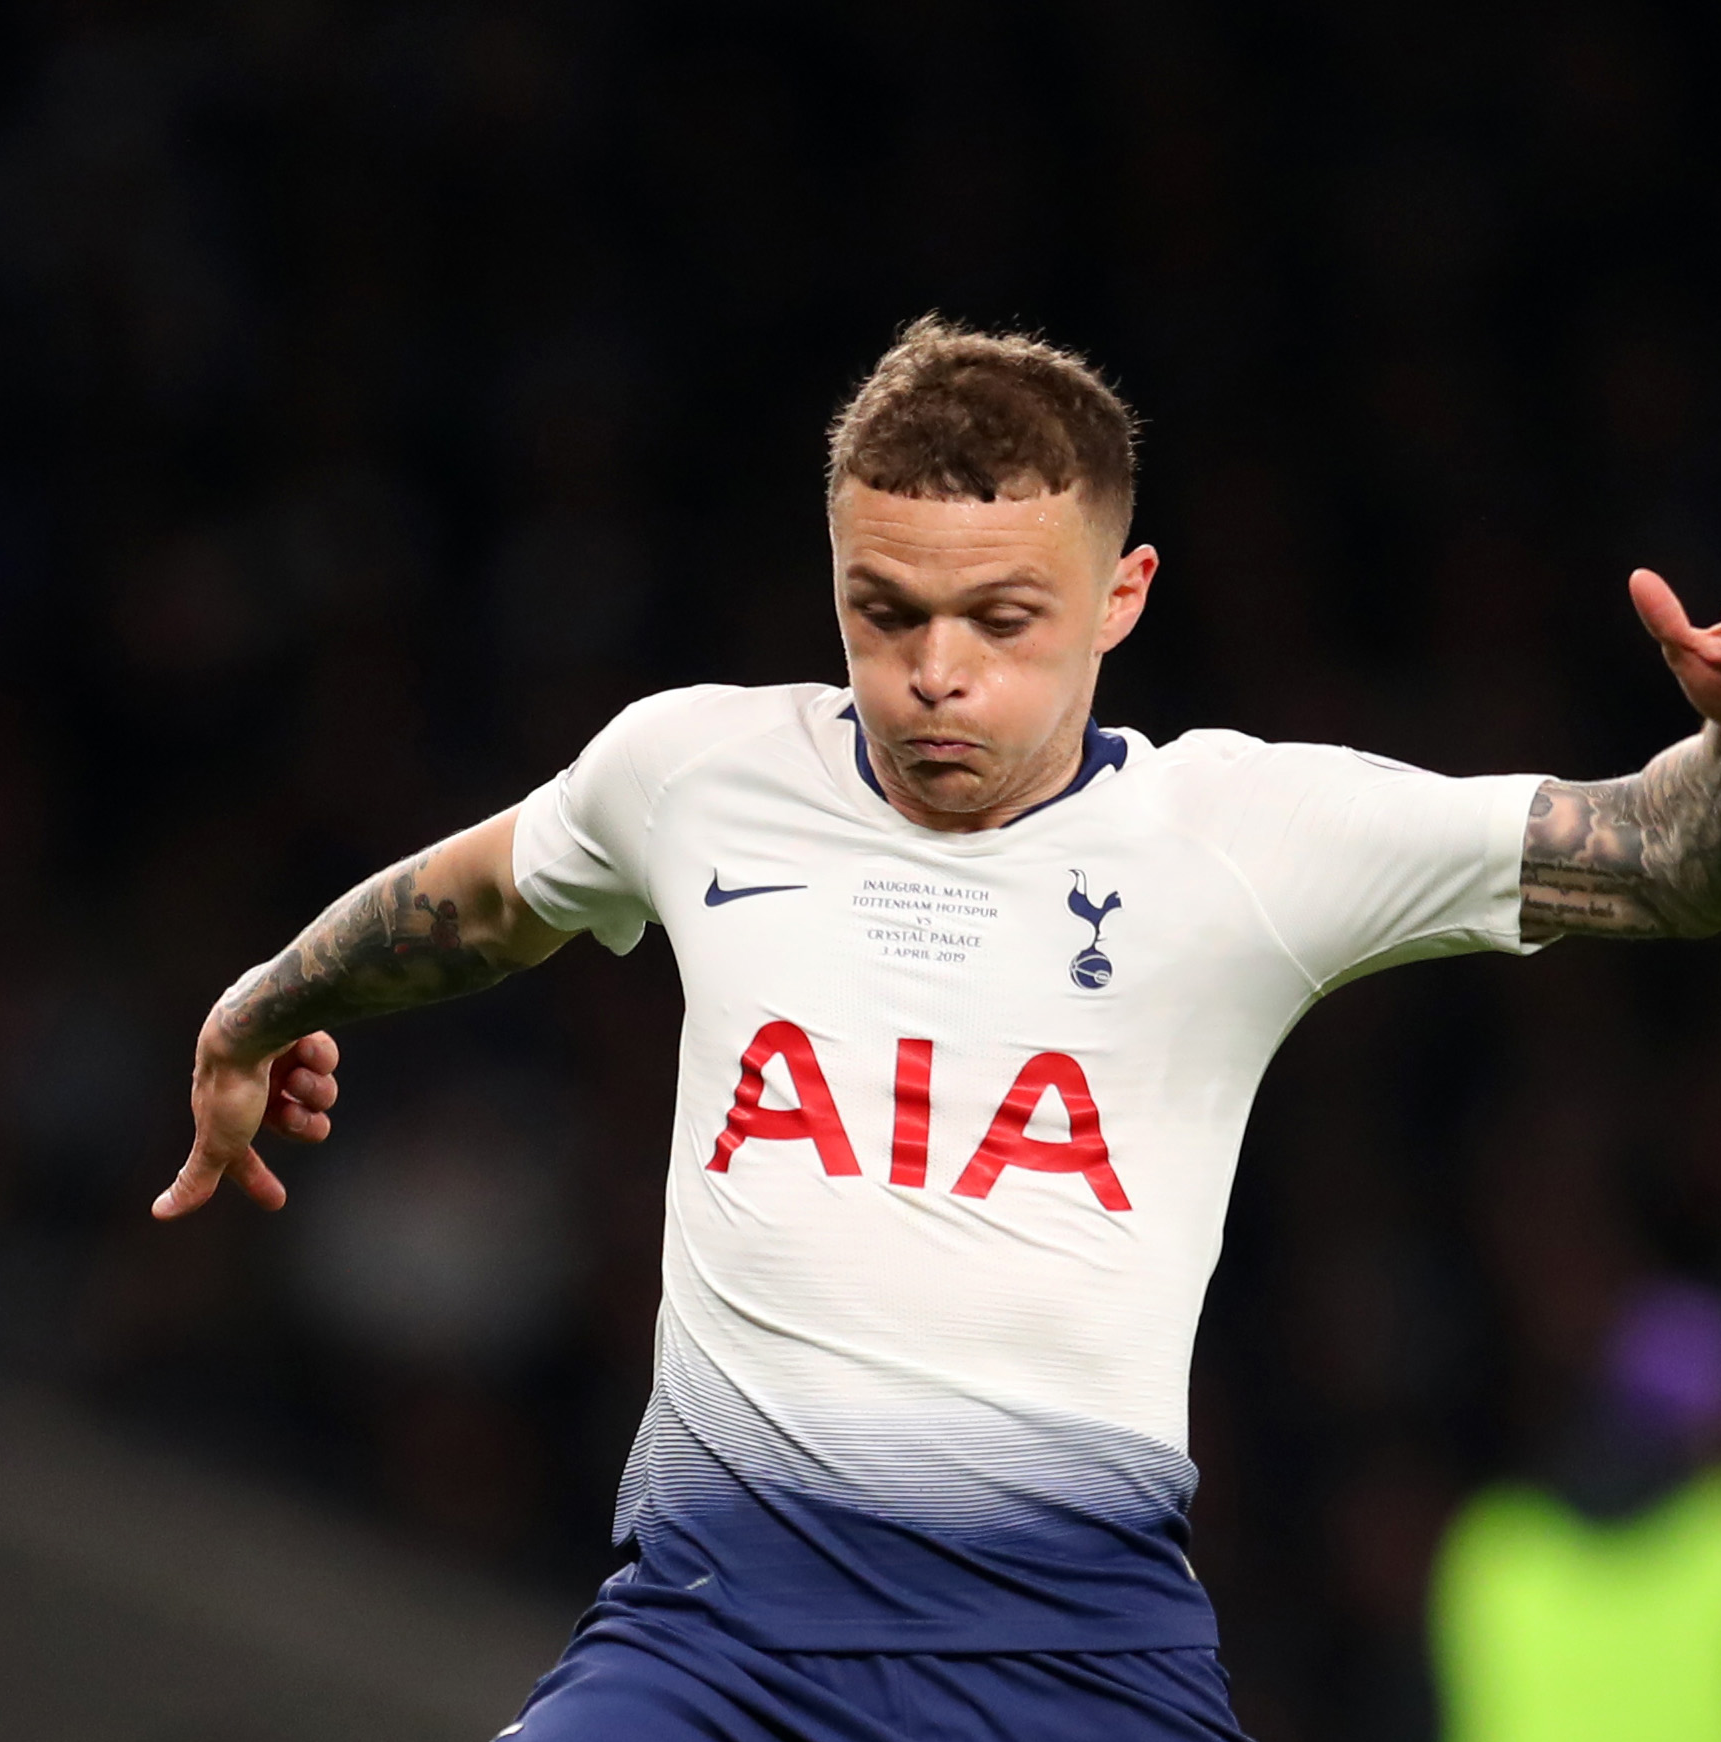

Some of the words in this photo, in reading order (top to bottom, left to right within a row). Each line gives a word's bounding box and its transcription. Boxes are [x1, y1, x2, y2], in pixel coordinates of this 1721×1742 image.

[863, 880, 939, 896] INAUGURAL
[943, 887, 989, 901] MATCH
[852, 895, 932, 910] TOTTENHAM
[936, 903, 998, 918] HOTSPUR
[867, 929, 925, 943] CRYSTAL
[930, 932, 982, 948] PALACE
[894, 948, 930, 961] APRIL
[935, 951, 966, 963] 2019
[705, 1020, 1132, 1211] AIA
